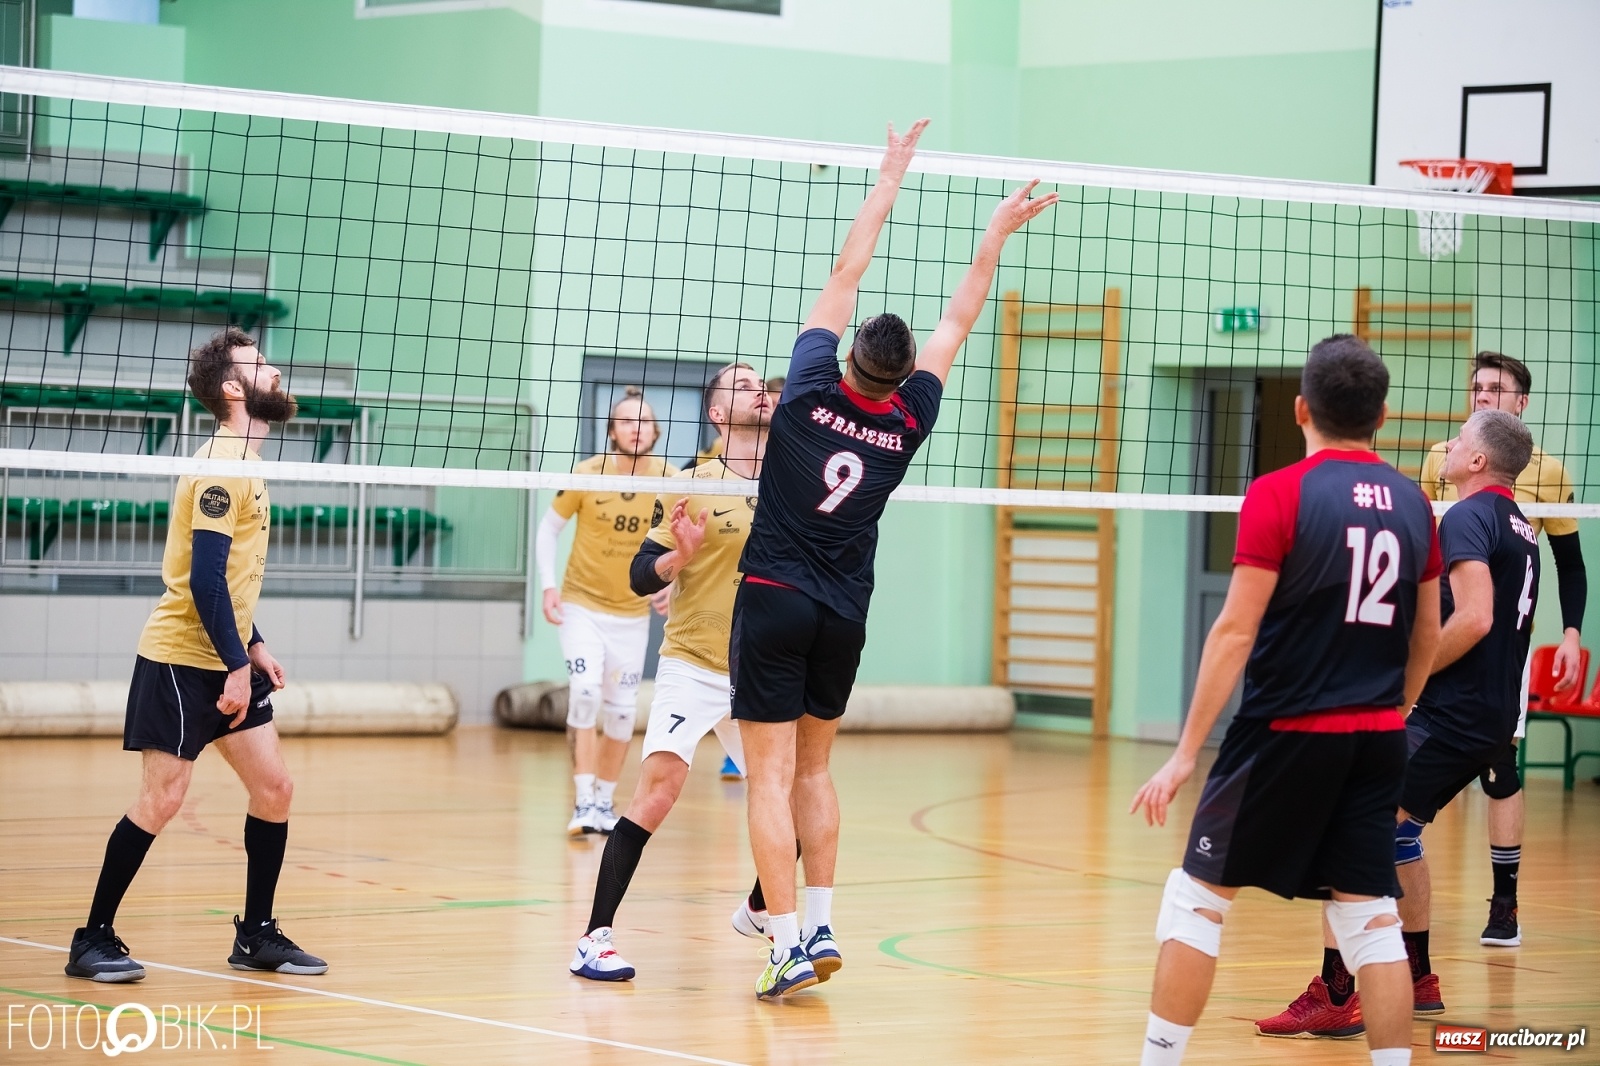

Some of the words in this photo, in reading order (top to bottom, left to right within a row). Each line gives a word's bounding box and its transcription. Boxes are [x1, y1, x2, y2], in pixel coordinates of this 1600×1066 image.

[811, 405, 904, 452] #RAJCHEL
[816, 450, 865, 514] 9
[614, 514, 640, 533] 88
[1344, 526, 1401, 627] 12
[1516, 554, 1534, 631] 4
[668, 713, 686, 734] 7
